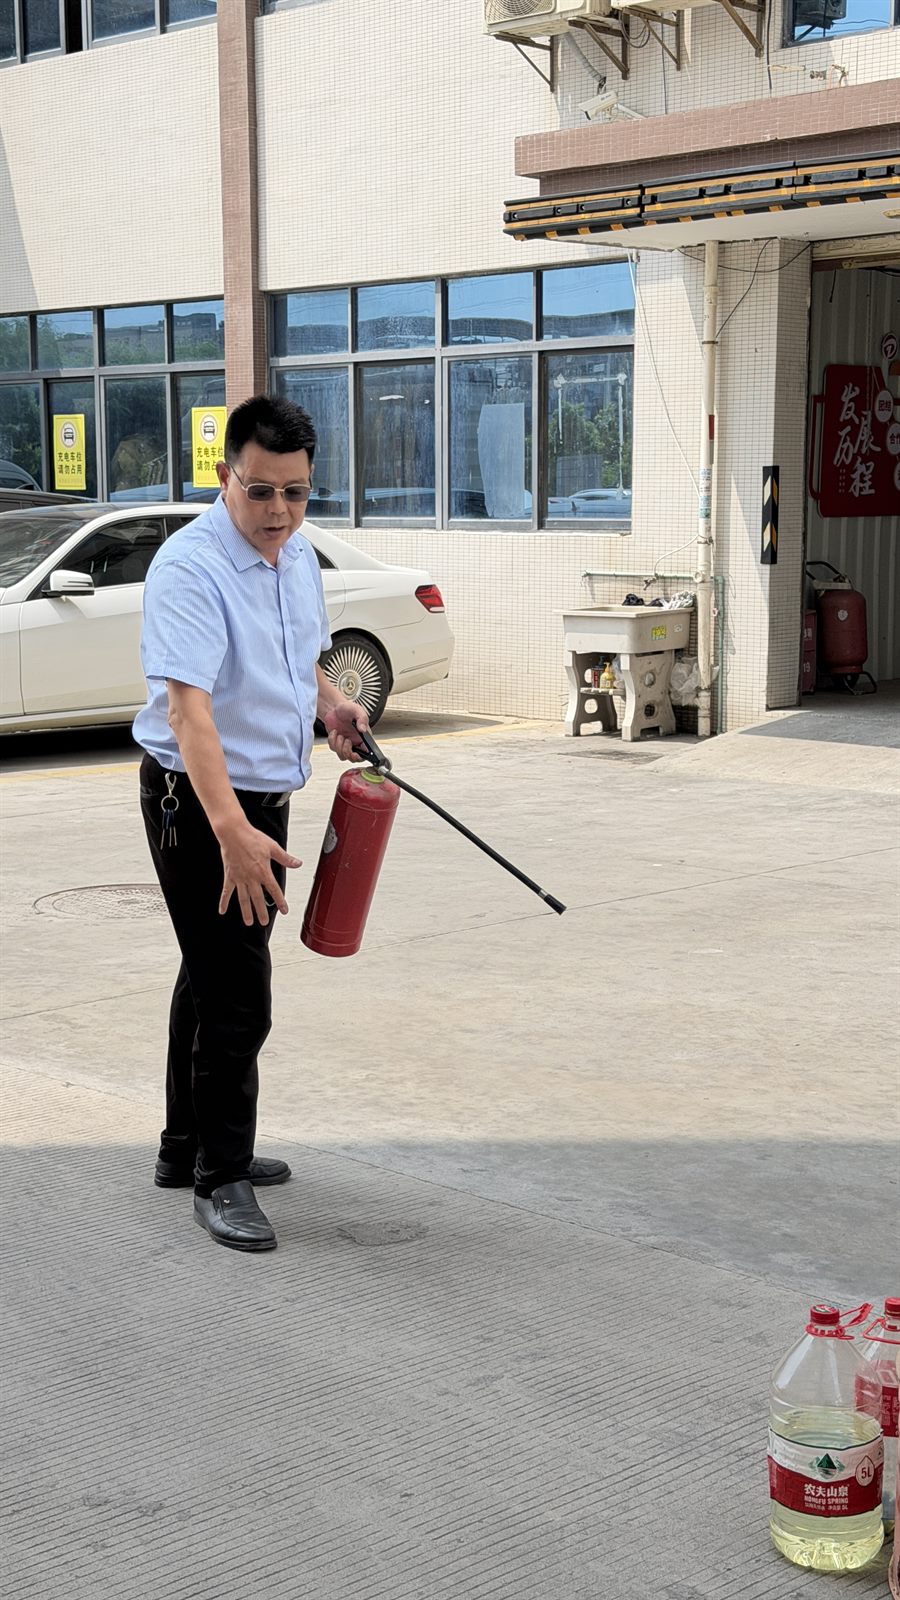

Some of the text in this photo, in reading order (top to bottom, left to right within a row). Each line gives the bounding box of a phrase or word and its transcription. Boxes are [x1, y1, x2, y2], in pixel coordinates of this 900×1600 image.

[58, 452, 82, 461] 充电车位
[197, 447, 223, 458] 充电车位
[58, 465, 82, 474] 请勿占用
[197, 461, 217, 471] 请勿占
[861, 1467, 872, 1480] 5L
[804, 1484, 848, 1497] 农夫山泉
